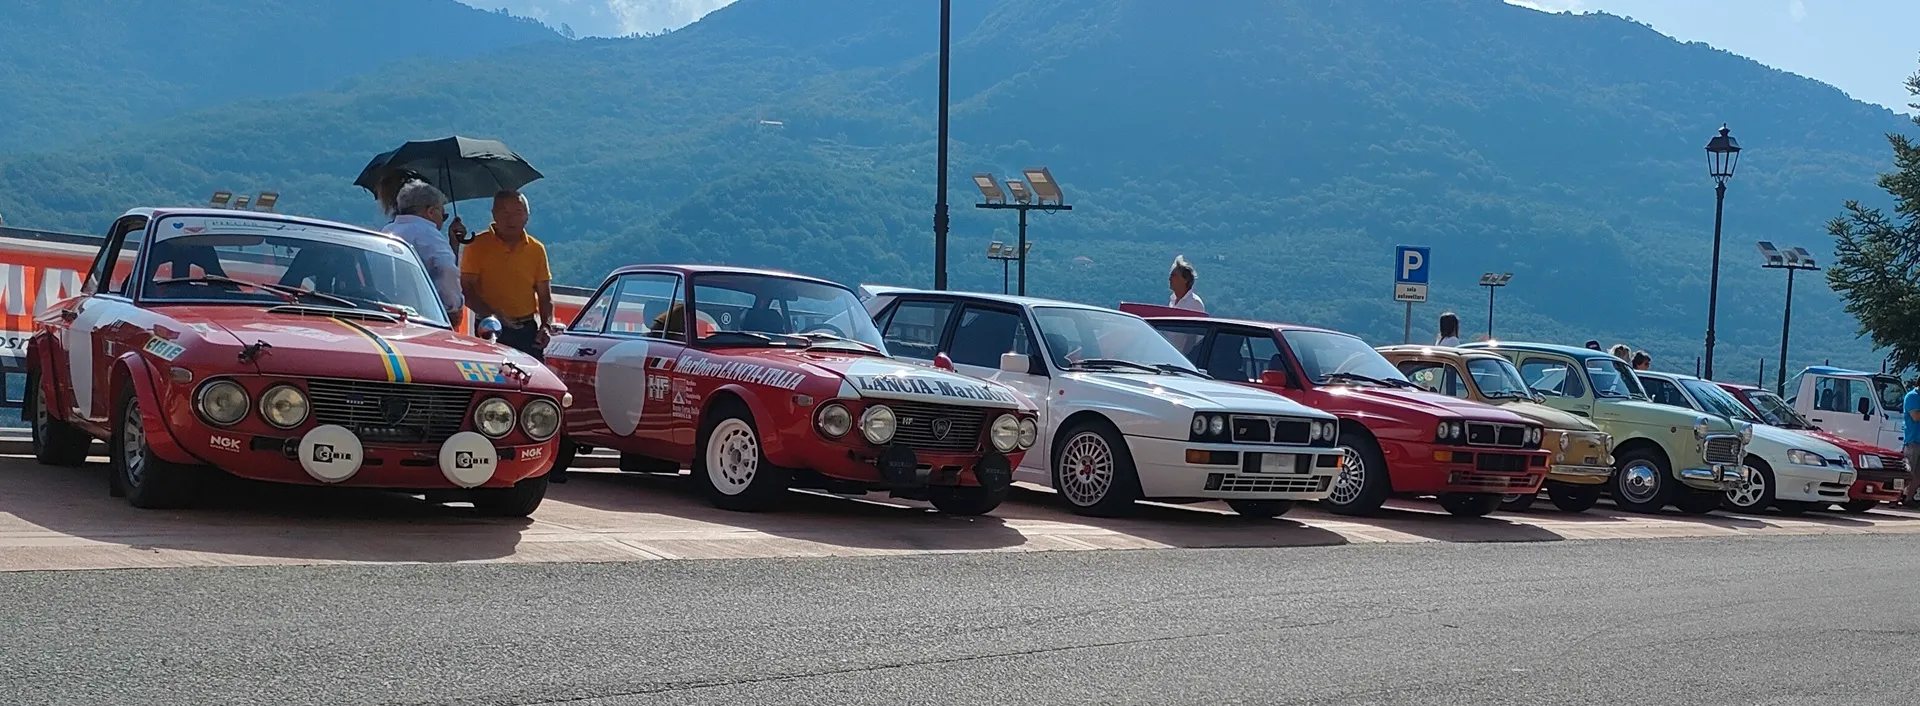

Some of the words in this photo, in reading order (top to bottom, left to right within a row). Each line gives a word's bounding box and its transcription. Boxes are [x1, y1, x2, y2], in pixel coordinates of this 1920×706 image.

[1403, 250, 1423, 280] P
[455, 360, 500, 383] HF
[673, 355, 723, 377] Marlboro
[648, 374, 671, 402] HF
[857, 376, 1017, 403] LANCIA-Marlboro
[210, 435, 242, 450] NGK
[521, 447, 543, 459] NGK
